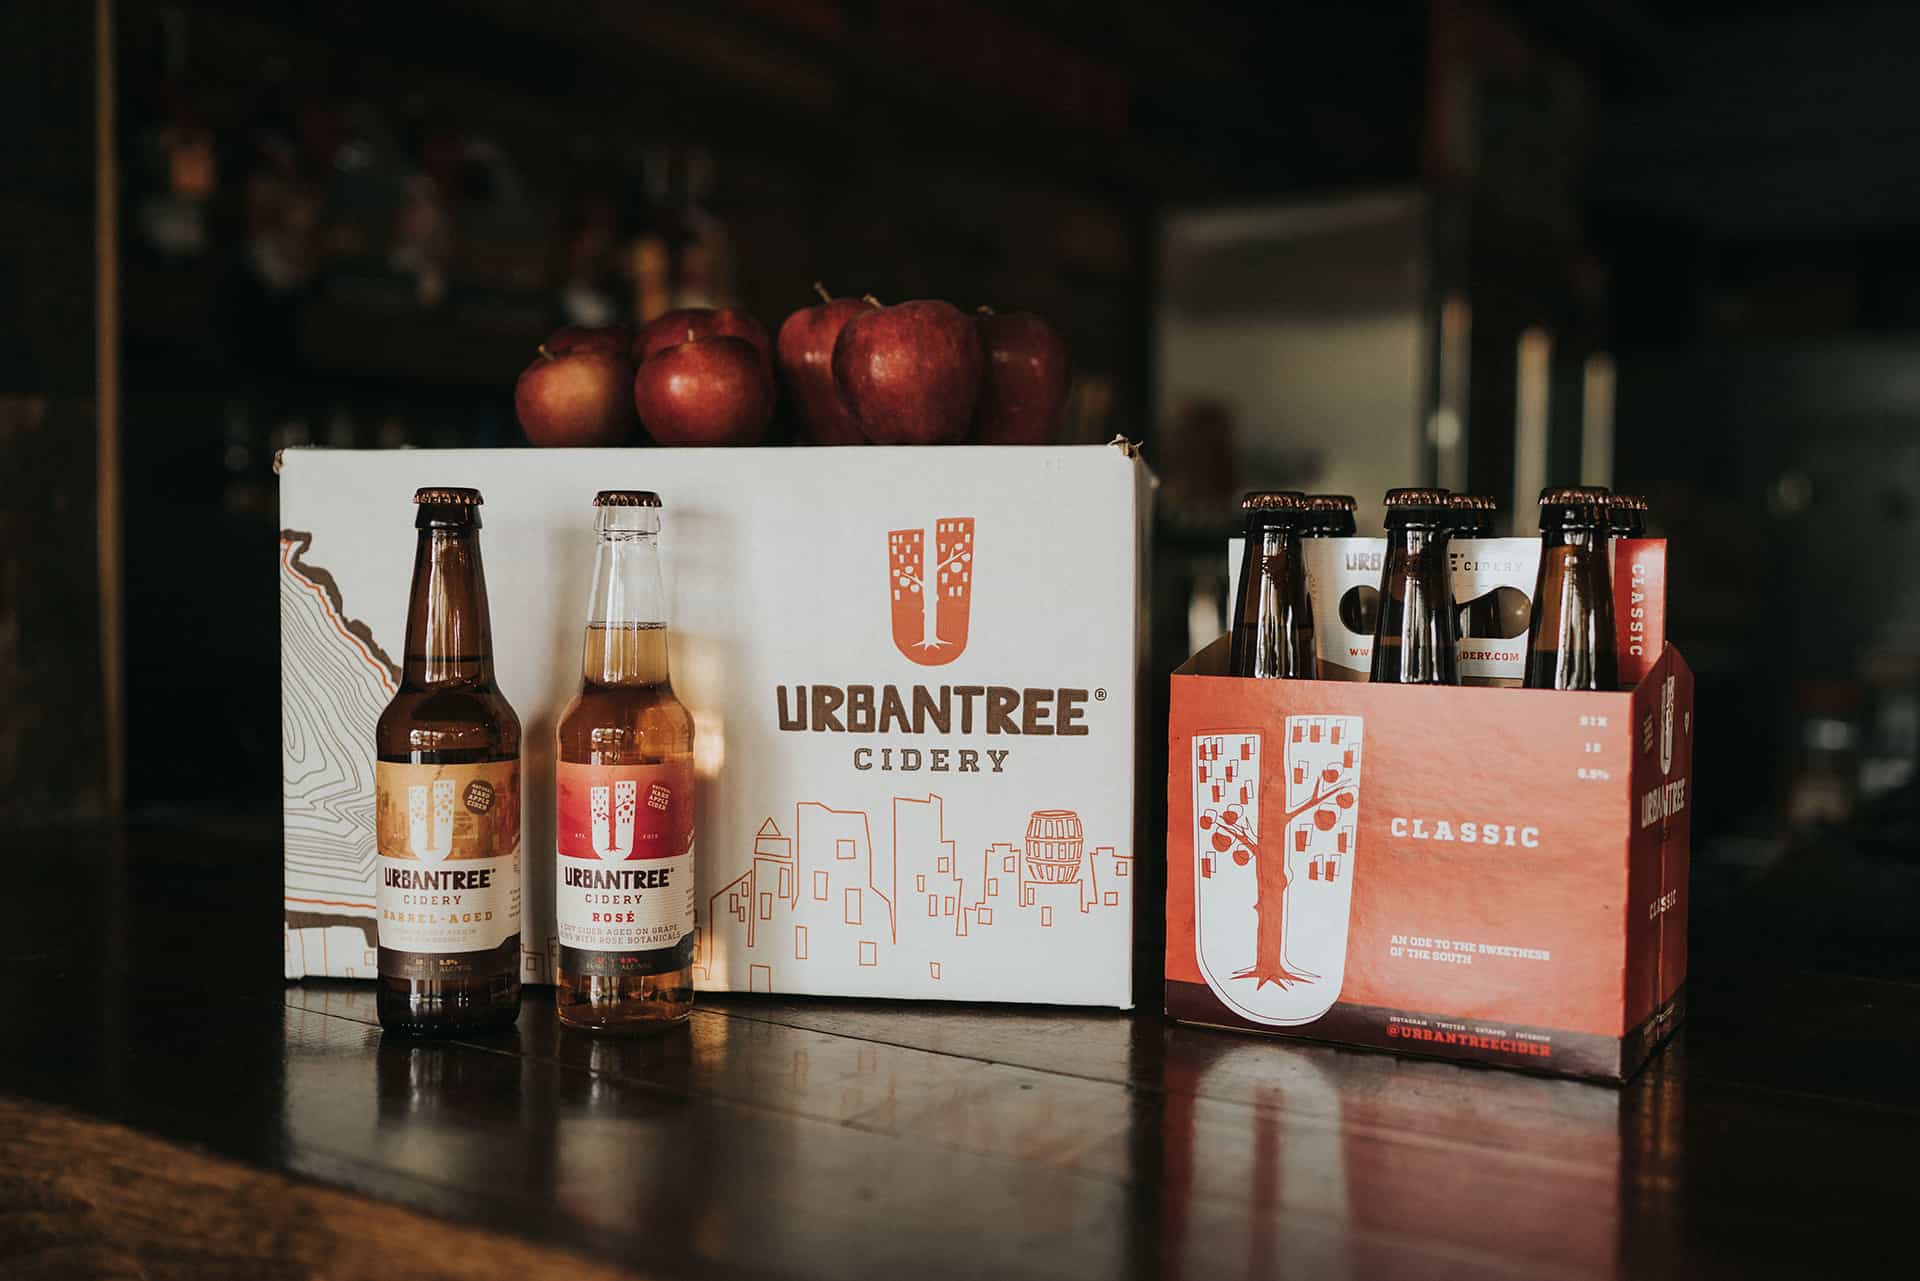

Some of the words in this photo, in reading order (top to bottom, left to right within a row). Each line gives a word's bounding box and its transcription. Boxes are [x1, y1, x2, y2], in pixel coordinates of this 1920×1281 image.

[1630, 563, 1645, 656] CLASSIC
[853, 747, 1009, 773] CIDERY
[1390, 816, 1540, 849] CLASSIC
[384, 866, 492, 891] URBANTREE
[564, 866, 670, 890] URBANTREE
[403, 894, 462, 905] CIDERY
[585, 894, 642, 904] CIDERY
[592, 910, 635, 922] ROSÉ
[606, 928, 633, 936] AGED
[1390, 947, 1404, 956] OF
[1407, 949, 1430, 960] THE
[1432, 951, 1472, 964] SOUTH
[1391, 935, 1407, 945] AN
[1410, 937, 1432, 948] ODE
[1435, 939, 1450, 949] TO
[1453, 941, 1476, 952] THE
[1478, 943, 1550, 961] SWEETNESS
[1386, 1023, 1551, 1057] @URBANTREECIDER
